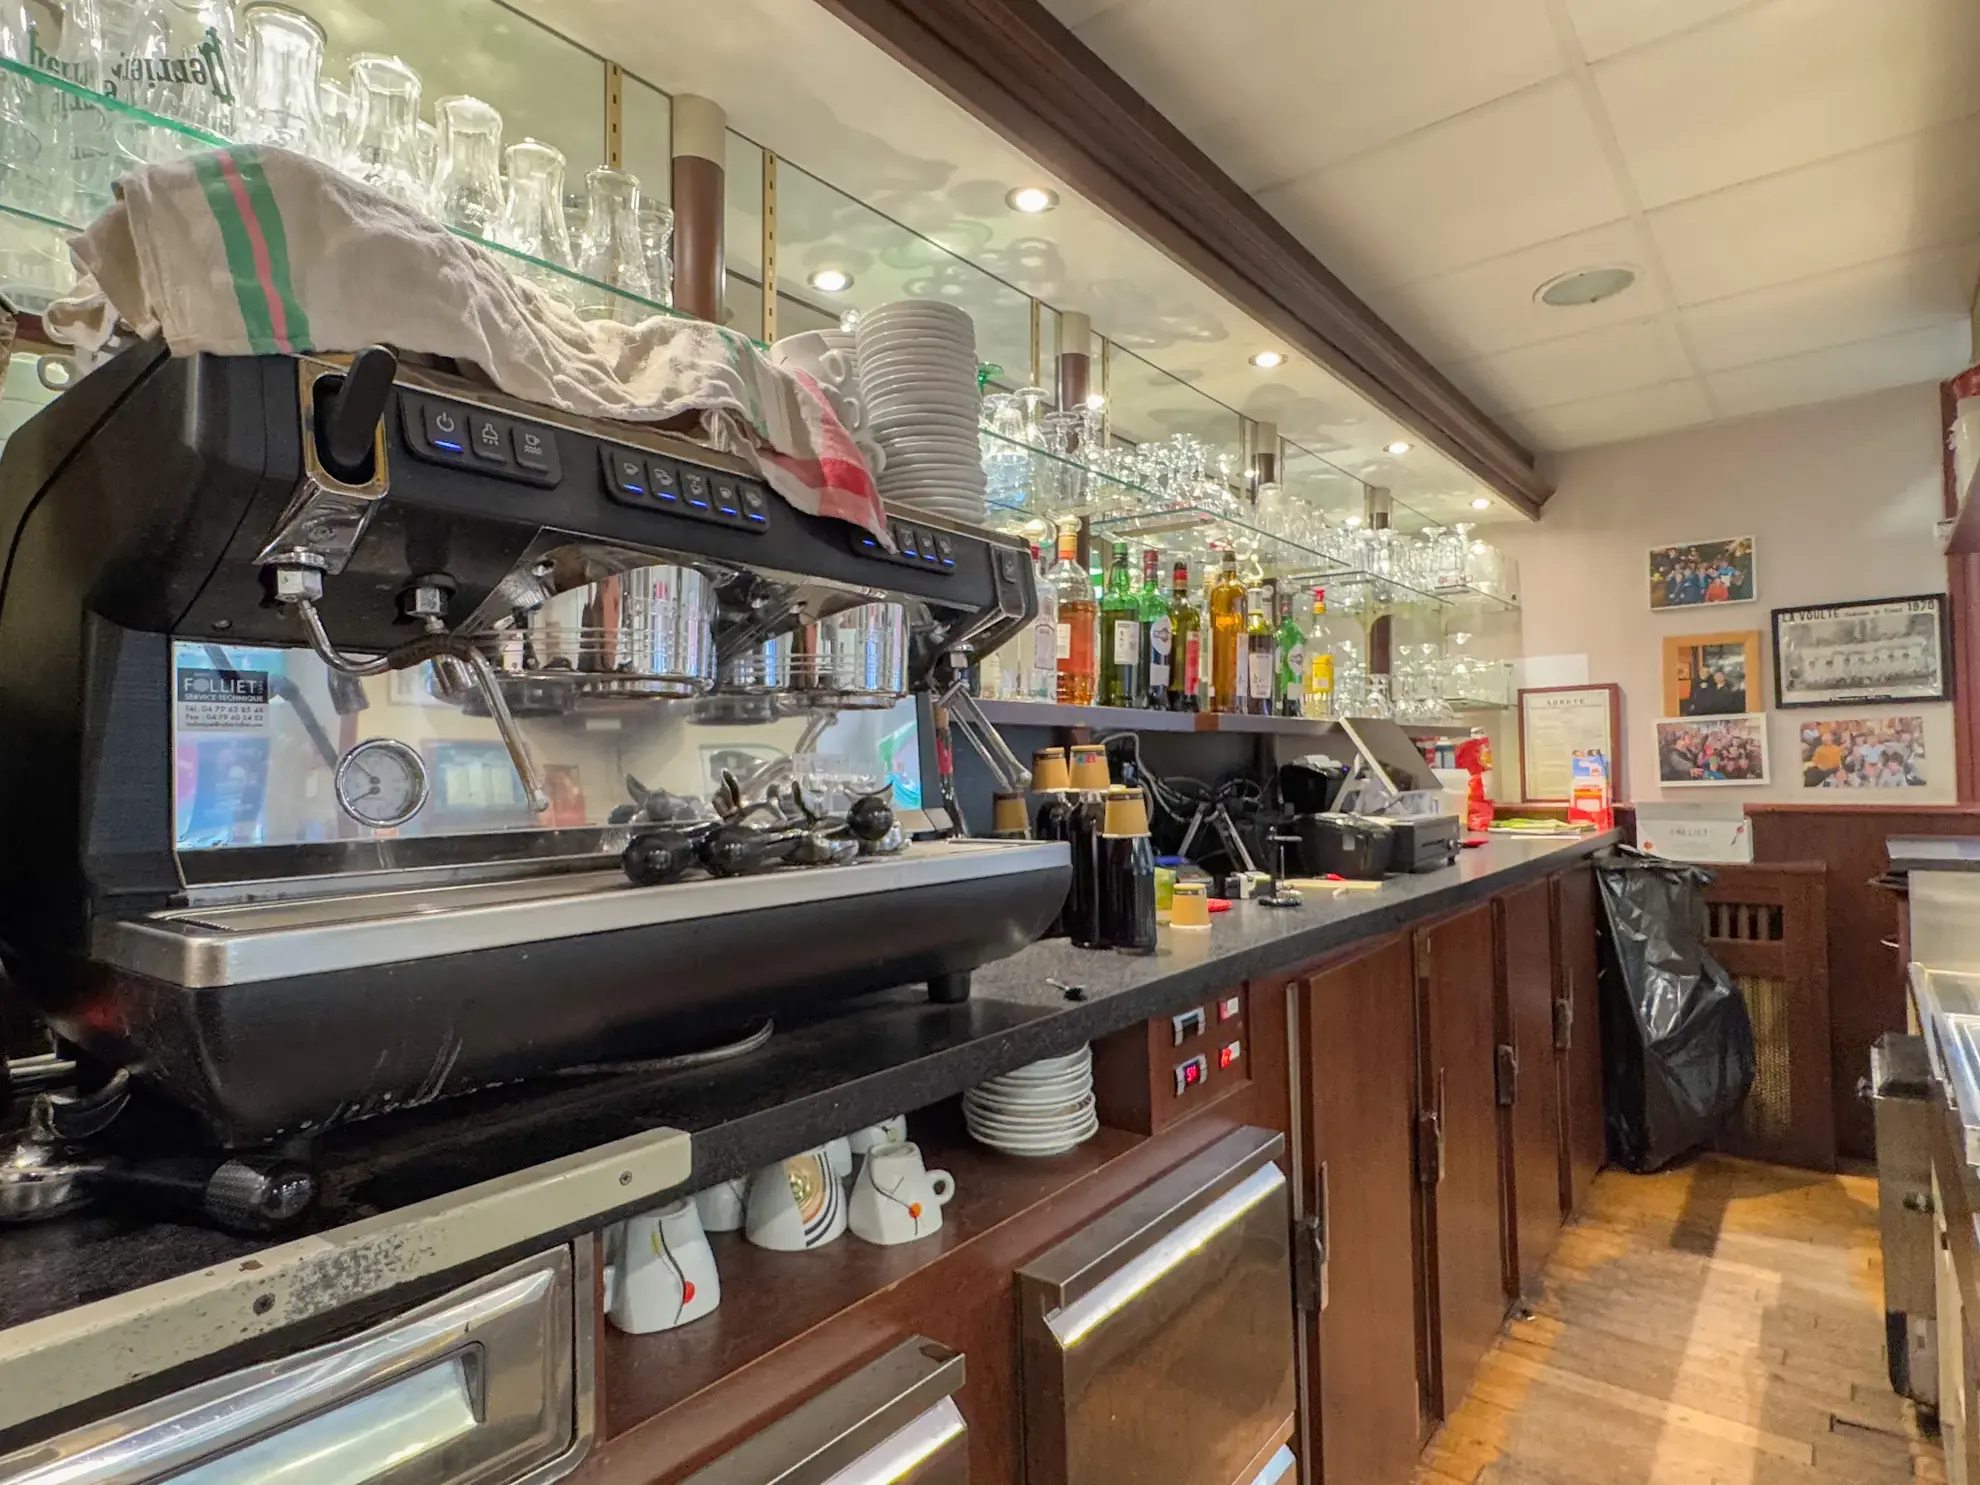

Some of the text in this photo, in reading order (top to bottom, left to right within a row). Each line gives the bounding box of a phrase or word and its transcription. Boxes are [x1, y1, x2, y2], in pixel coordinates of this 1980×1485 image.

[1799, 608, 1839, 621] VOULTE
[184, 677, 257, 694] FOLLIET
[184, 693, 264, 703] SERVICE TECHNIQUE
